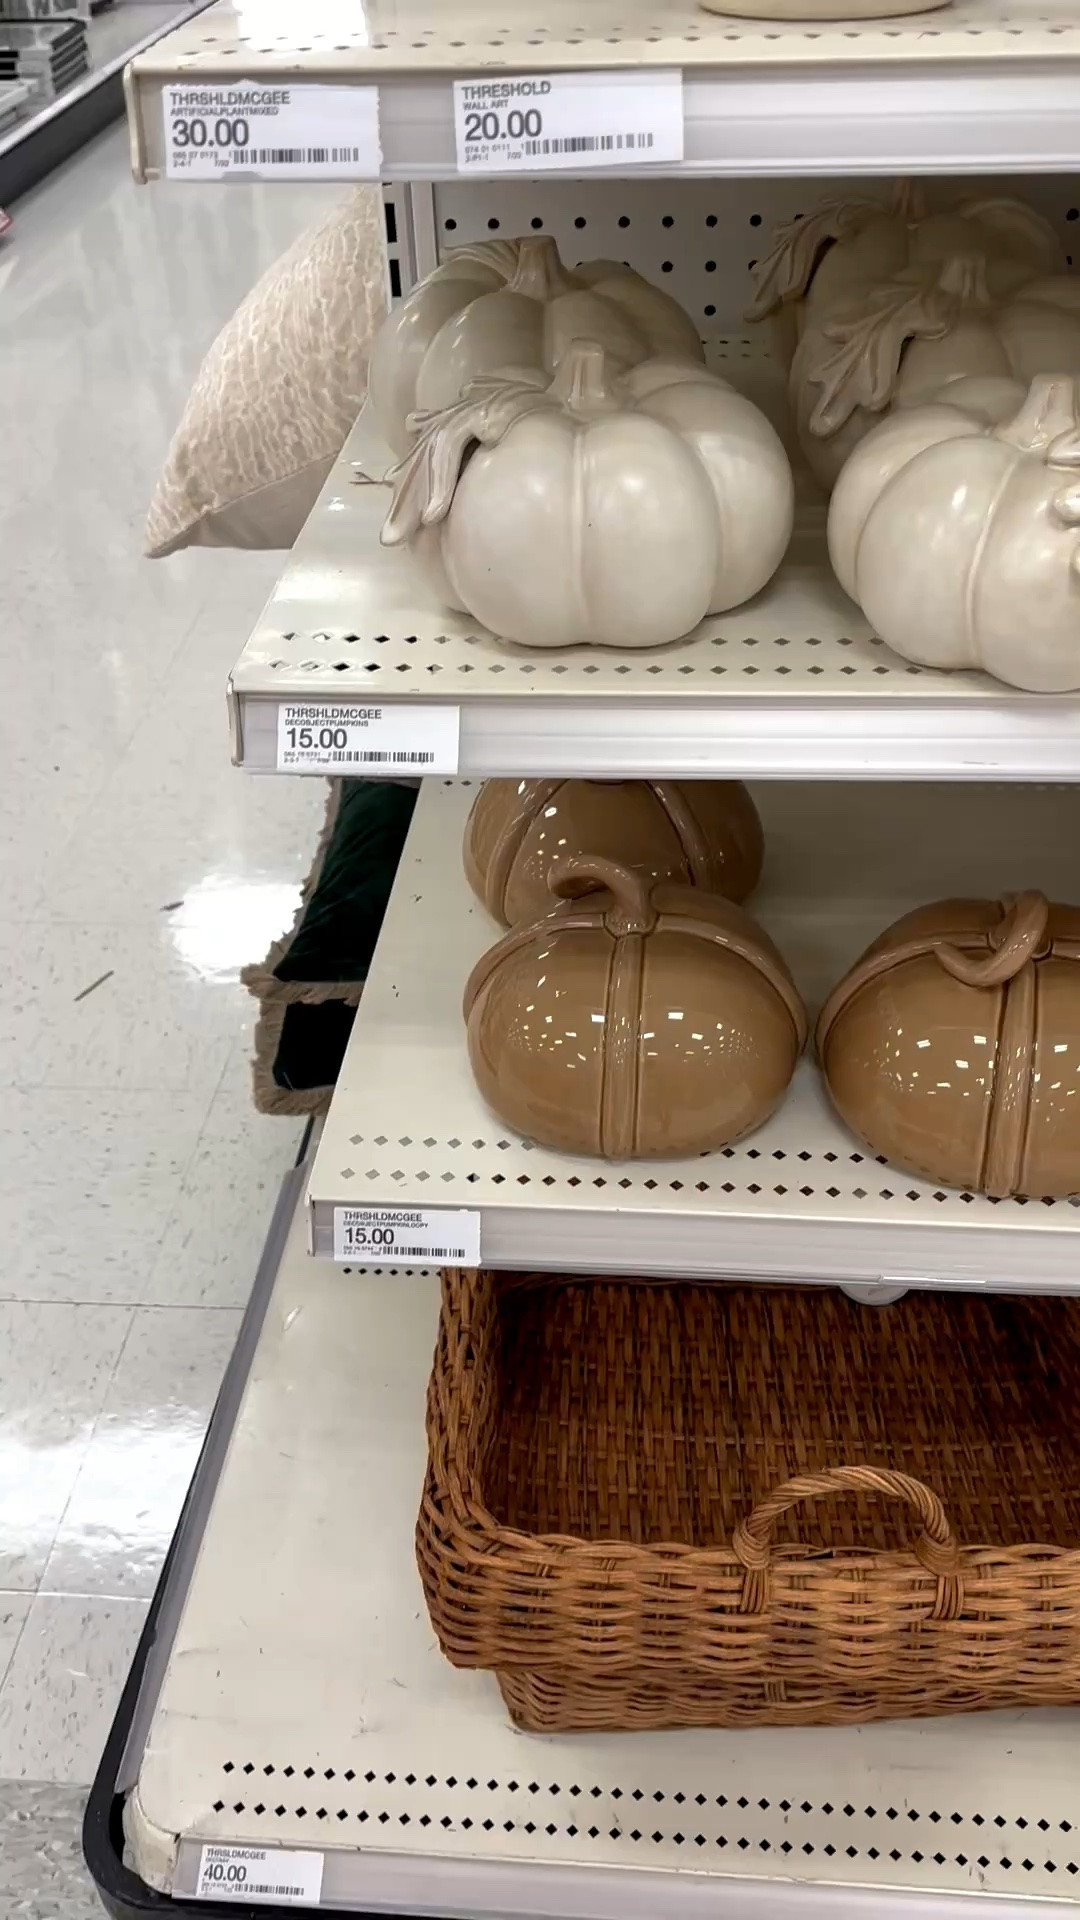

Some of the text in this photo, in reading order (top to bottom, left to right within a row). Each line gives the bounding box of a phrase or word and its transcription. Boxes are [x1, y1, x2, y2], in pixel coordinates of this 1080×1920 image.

[170, 91, 291, 105] THRSHLDMCGEE
[461, 80, 551, 100] THRESHOLD
[463, 99, 509, 111] WALL ART
[172, 118, 249, 147] 30.00
[464, 108, 542, 142] 20.00
[285, 708, 382, 720] THRSHLDMCGEE
[286, 727, 347, 749] 15.00
[344, 1211, 422, 1222] THRSHLDMCGEE
[345, 1227, 394, 1245] 15.00
[204, 1863, 247, 1882] 40.00
